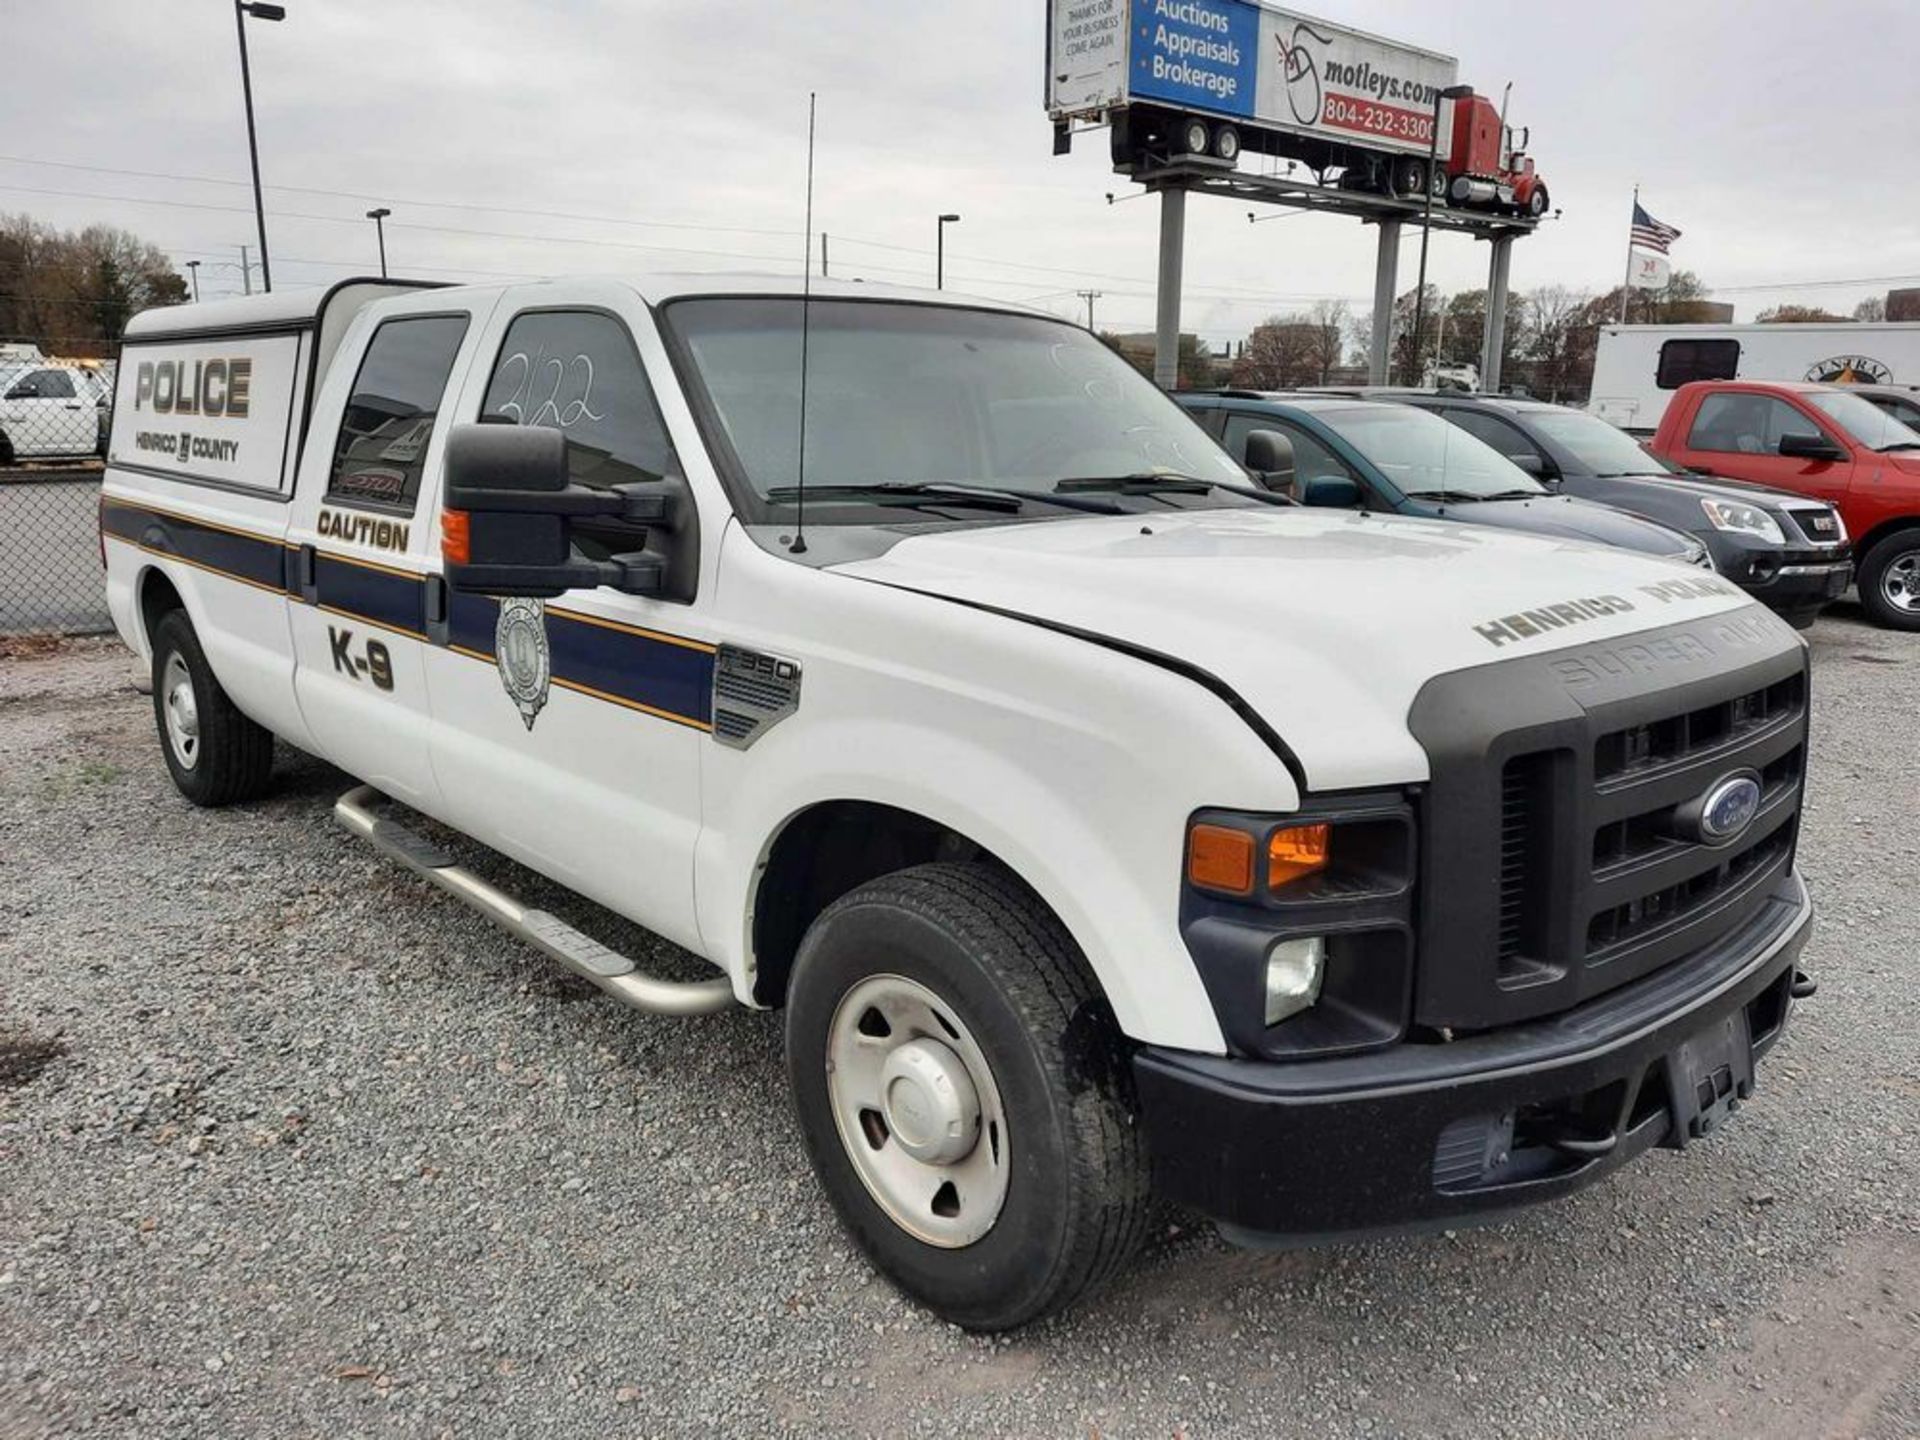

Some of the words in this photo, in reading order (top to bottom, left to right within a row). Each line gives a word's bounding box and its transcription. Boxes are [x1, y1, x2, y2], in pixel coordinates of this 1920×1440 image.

[1155, 0, 1229, 33] Auctions
[1154, 23, 1240, 66] Appraisals
[1153, 54, 1238, 99] Brokerage
[1324, 60, 1438, 105] motleys.com
[135, 358, 252, 418] POLICE
[136, 431, 177, 454] HENRICO
[192, 436, 239, 462] COUNTY
[317, 510, 409, 552] CAUTION
[1472, 594, 1636, 647] HENRICO
[328, 626, 394, 692] K-9
